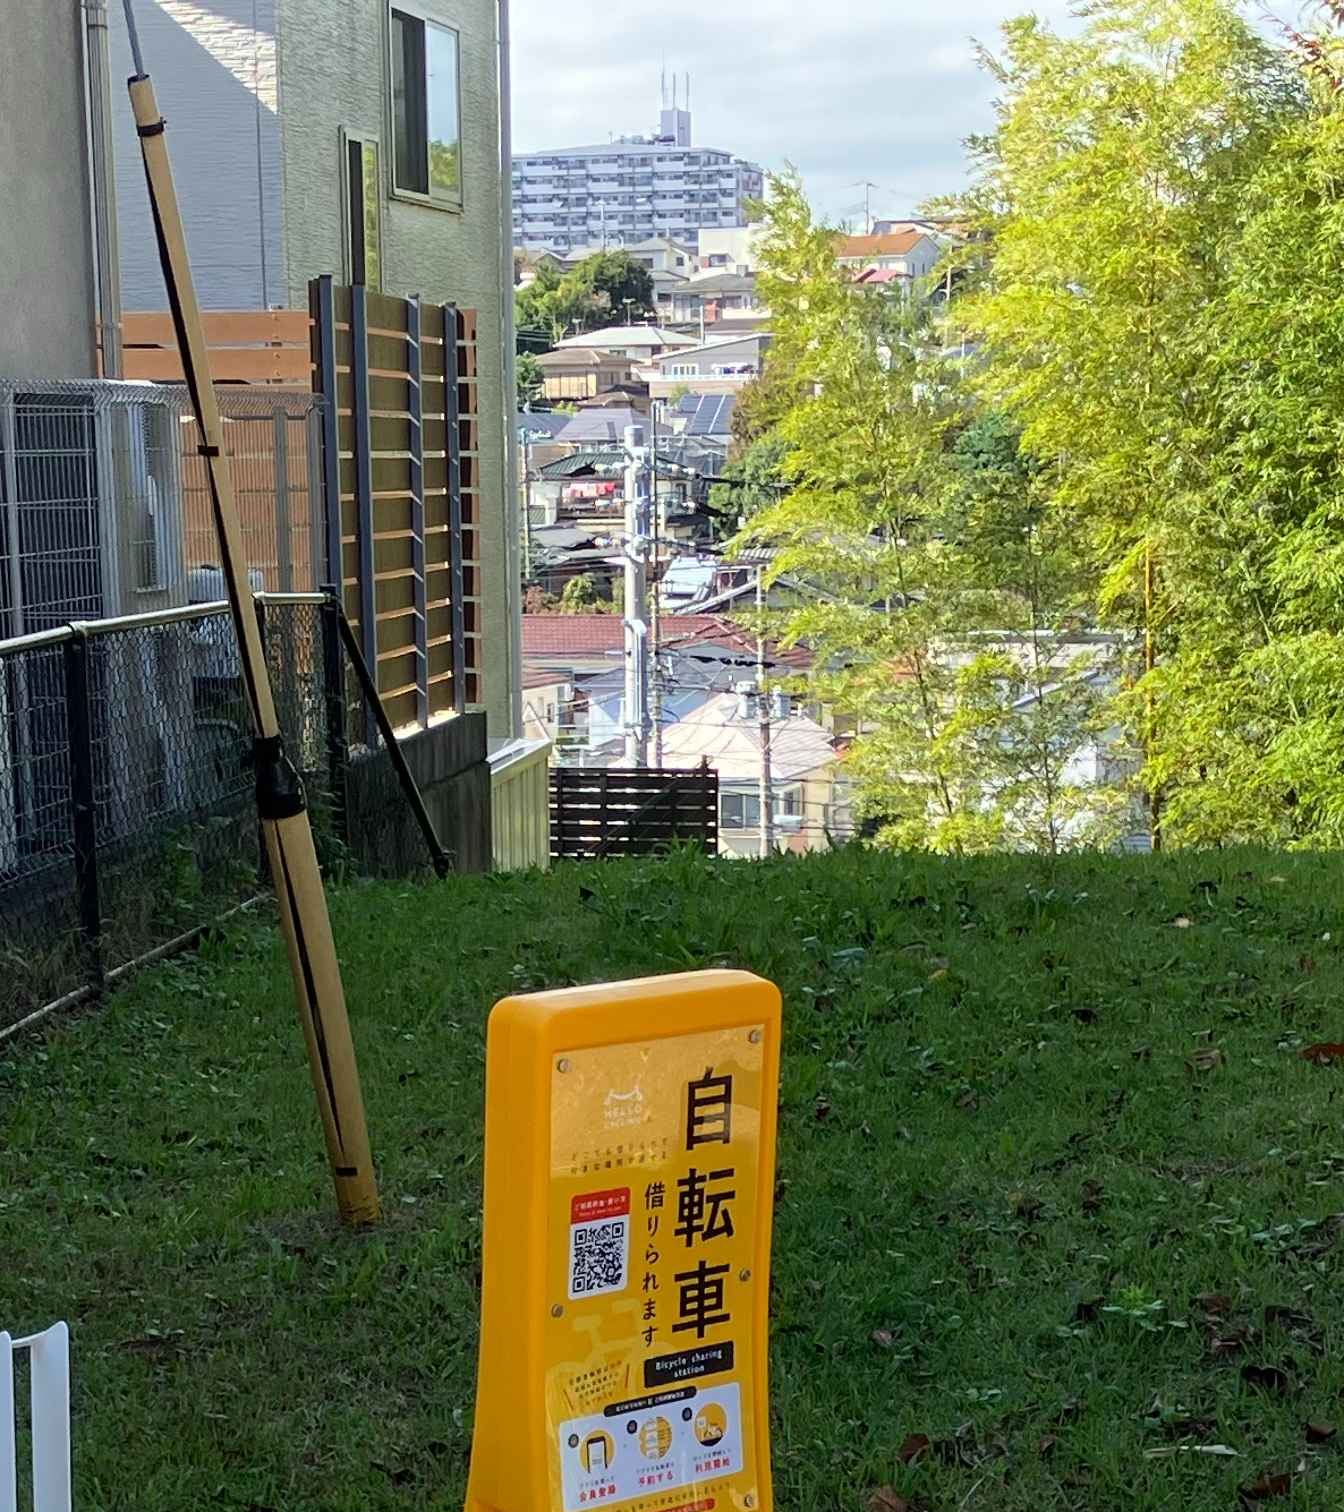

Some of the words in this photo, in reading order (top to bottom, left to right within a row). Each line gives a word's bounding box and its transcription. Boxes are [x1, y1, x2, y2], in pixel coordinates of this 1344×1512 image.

[671, 1065, 736, 1340] 自転車
[641, 1181, 666, 1348] 借りられます
[655, 1357, 687, 1372] Bicycle
[691, 1349, 723, 1364] sharing
[673, 1364, 705, 1378] station
